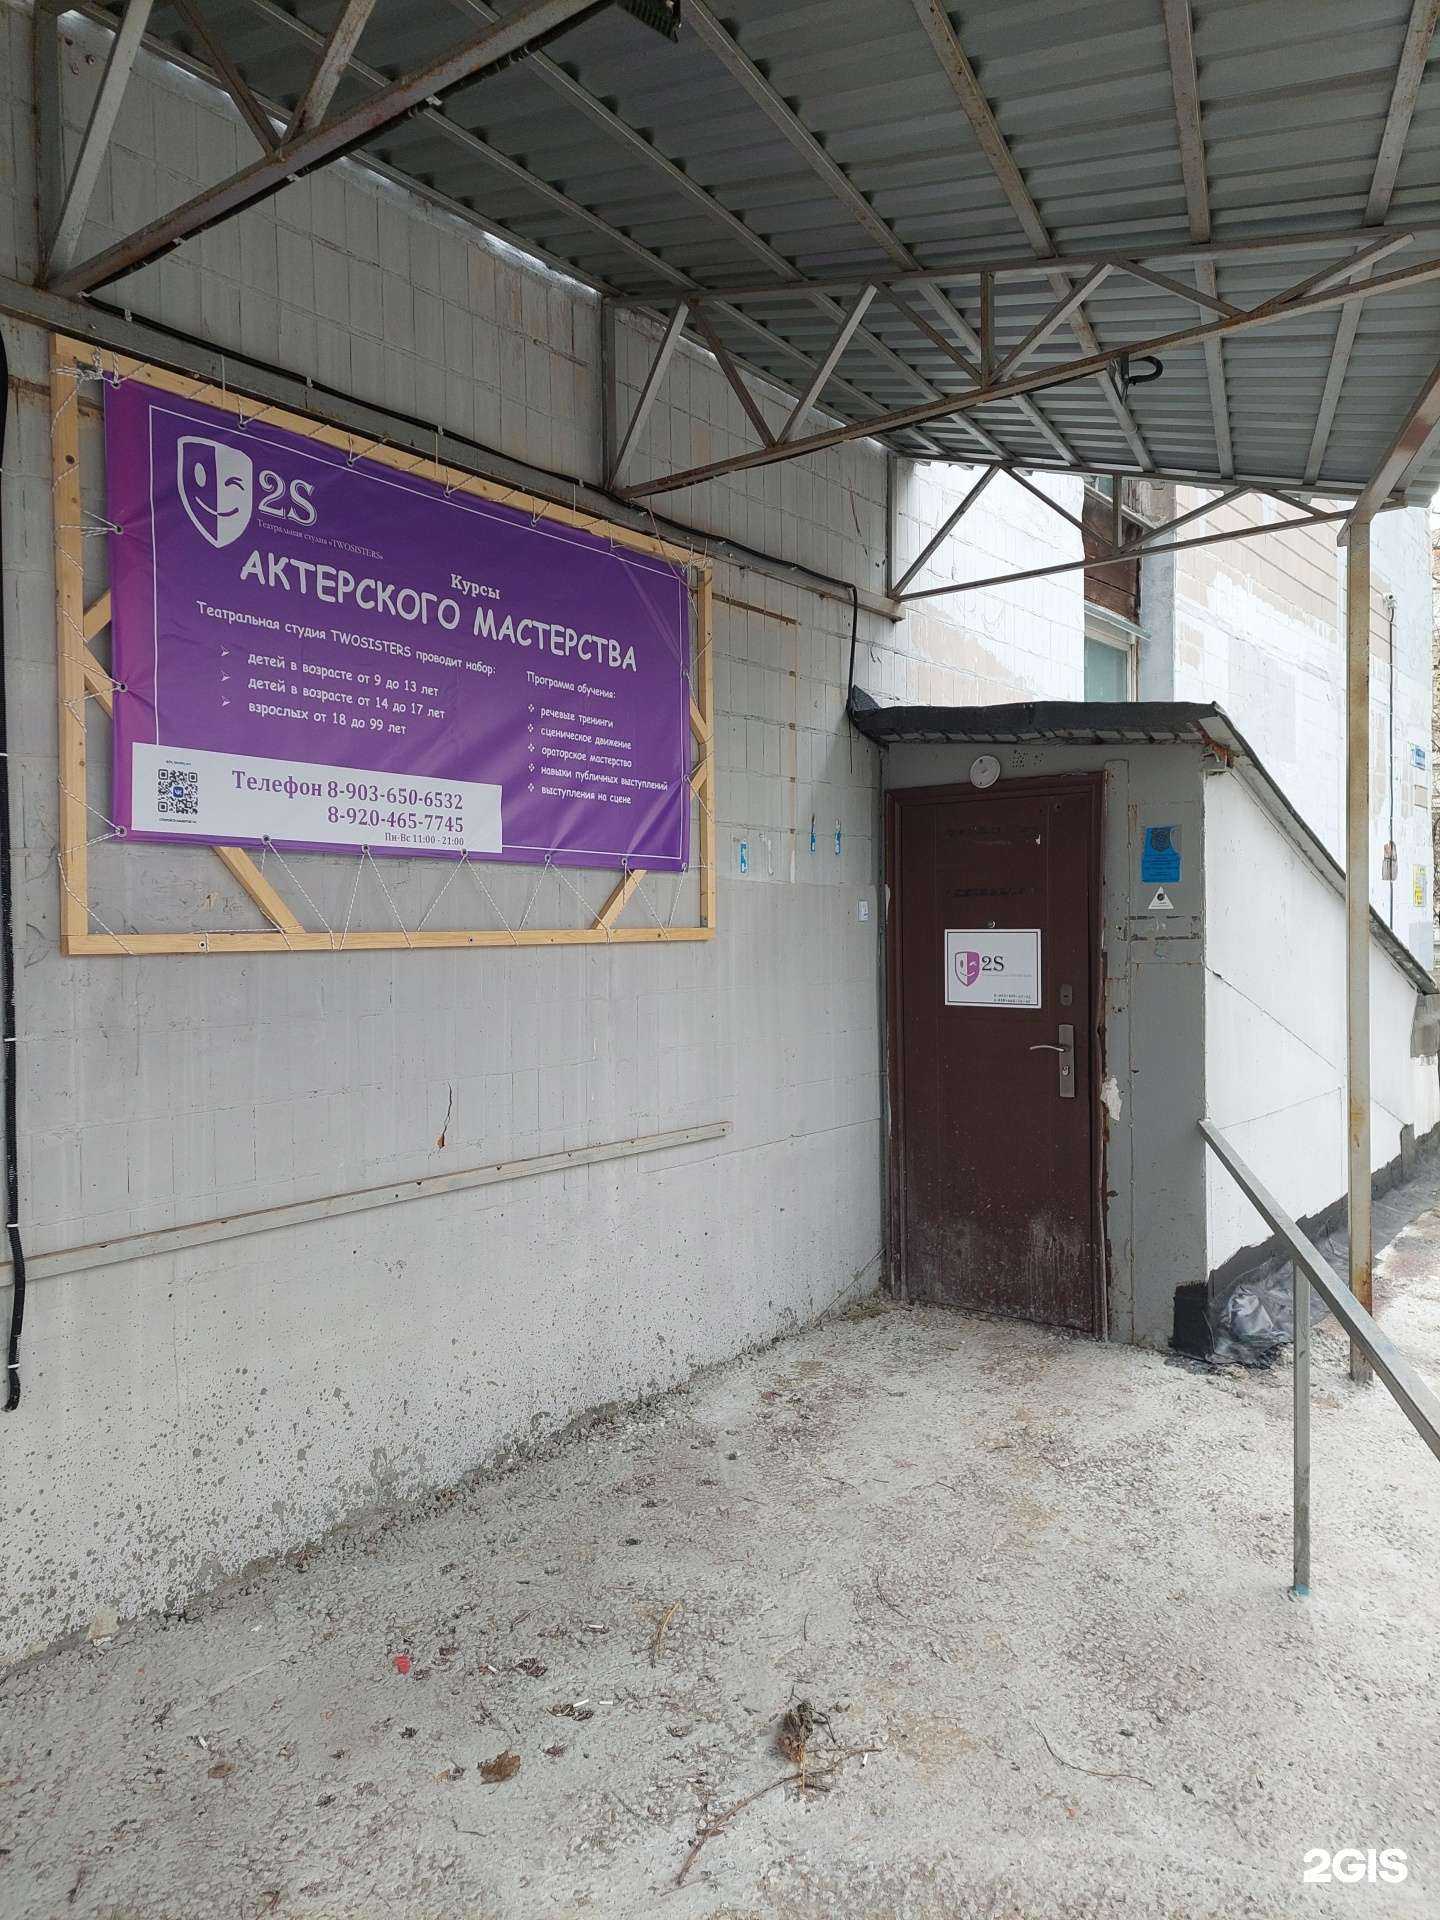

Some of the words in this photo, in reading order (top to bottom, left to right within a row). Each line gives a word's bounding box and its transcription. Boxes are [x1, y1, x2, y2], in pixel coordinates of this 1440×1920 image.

[258, 469, 317, 526] 2S
[450, 573, 501, 600] Курсы
[240, 550, 460, 630] АКТЕРСКОГО
[473, 607, 637, 672] МАСТЕРСТВА
[196, 600, 280, 630] Театральная
[285, 622, 326, 640] студия
[331, 630, 411, 657] TWOSISTERS
[416, 650, 462, 668] проводит
[466, 660, 496, 676] набор:
[247, 653, 285, 669] детей
[290, 661, 297, 671] в
[303, 663, 352, 680] возрасте
[357, 675, 370, 684] от
[374, 674, 381, 686] 9
[386, 680, 399, 690] до
[404, 680, 417, 692] 13
[421, 684, 439, 697] лет
[526, 671, 575, 691] Программа
[577, 683, 616, 699] обучения:
[247, 678, 285, 693] детей
[291, 685, 297, 695] в
[303, 687, 352, 704] возрасте
[358, 697, 370, 707] от
[376, 697, 388, 709] 14
[393, 703, 406, 713] до
[411, 703, 424, 715] 17
[427, 708, 445, 719] лет
[248, 702, 308, 720] взрослых
[314, 713, 326, 722] от
[333, 712, 346, 726] 18
[351, 718, 365, 729] до
[370, 719, 384, 730] 99
[388, 723, 408, 735] лет
[540, 707, 575, 721] речевые
[578, 714, 614, 728] тренинги
[540, 728, 592, 743] сценическое
[595, 735, 632, 750] движение
[541, 747, 587, 761] ораторское
[590, 755, 632, 768] мастерство
[232, 770, 322, 799] Телефон
[327, 780, 463, 810] 8-903-650-6532
[541, 766, 572, 778] навыки
[575, 770, 618, 784] публичных
[621, 777, 668, 791] выступлений
[541, 785, 595, 800] выступления
[598, 792, 607, 801] на
[610, 794, 632, 804] сцене
[327, 806, 464, 833] 8-920-465-7745
[384, 832, 412, 843] Пн-Вс
[413, 833, 435, 845] 11:00
[442, 834, 464, 846] 21:00
[982, 955, 1005, 972] 2S
